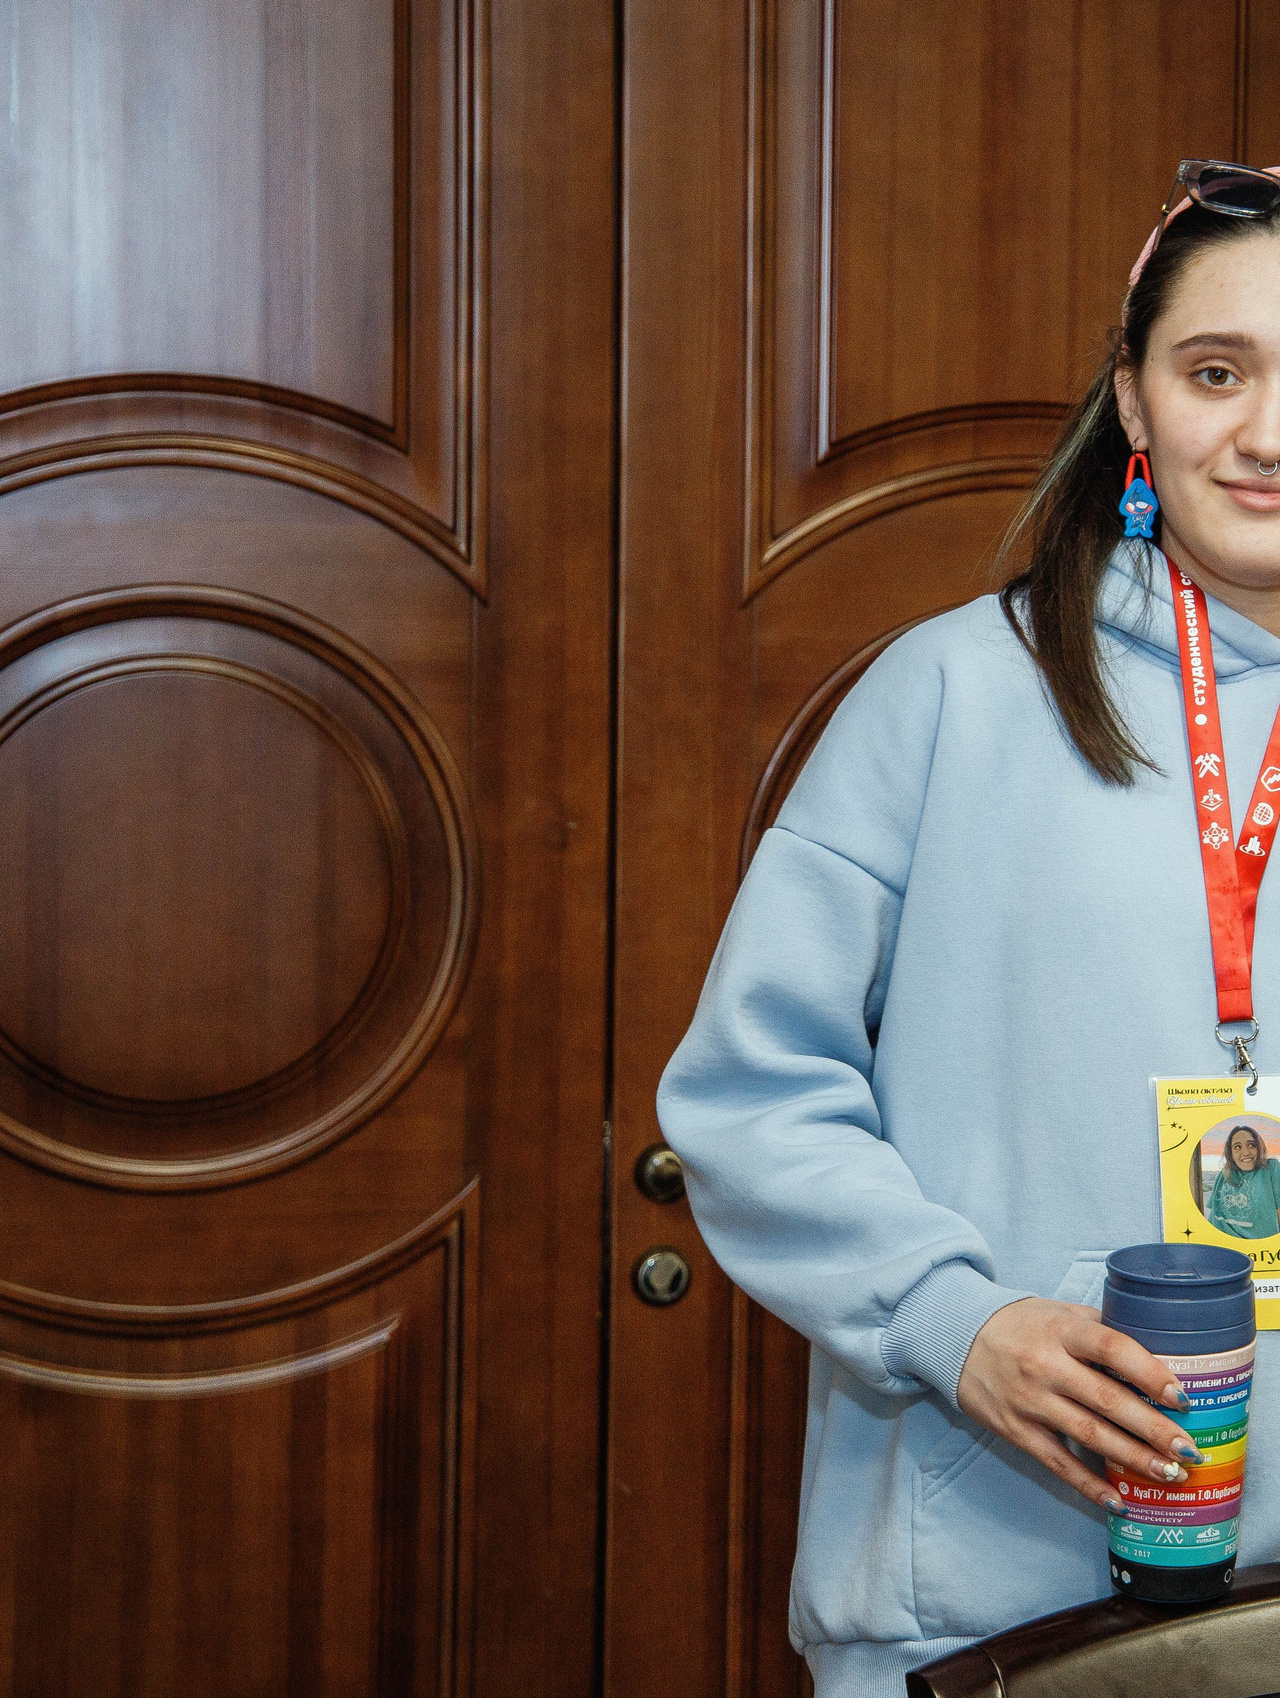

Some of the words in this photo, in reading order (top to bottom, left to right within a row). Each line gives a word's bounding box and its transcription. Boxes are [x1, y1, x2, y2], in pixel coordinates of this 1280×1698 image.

[1180, 589, 1207, 706] студенческий
[1192, 1378, 1222, 1389] ИМЕНИ
[1200, 1398, 1216, 1406] Т.Ф.
[1133, 1486, 1165, 1500] КузГТУ
[1166, 1492, 1196, 1501] имени
[1133, 1548, 1151, 1558] 2017
